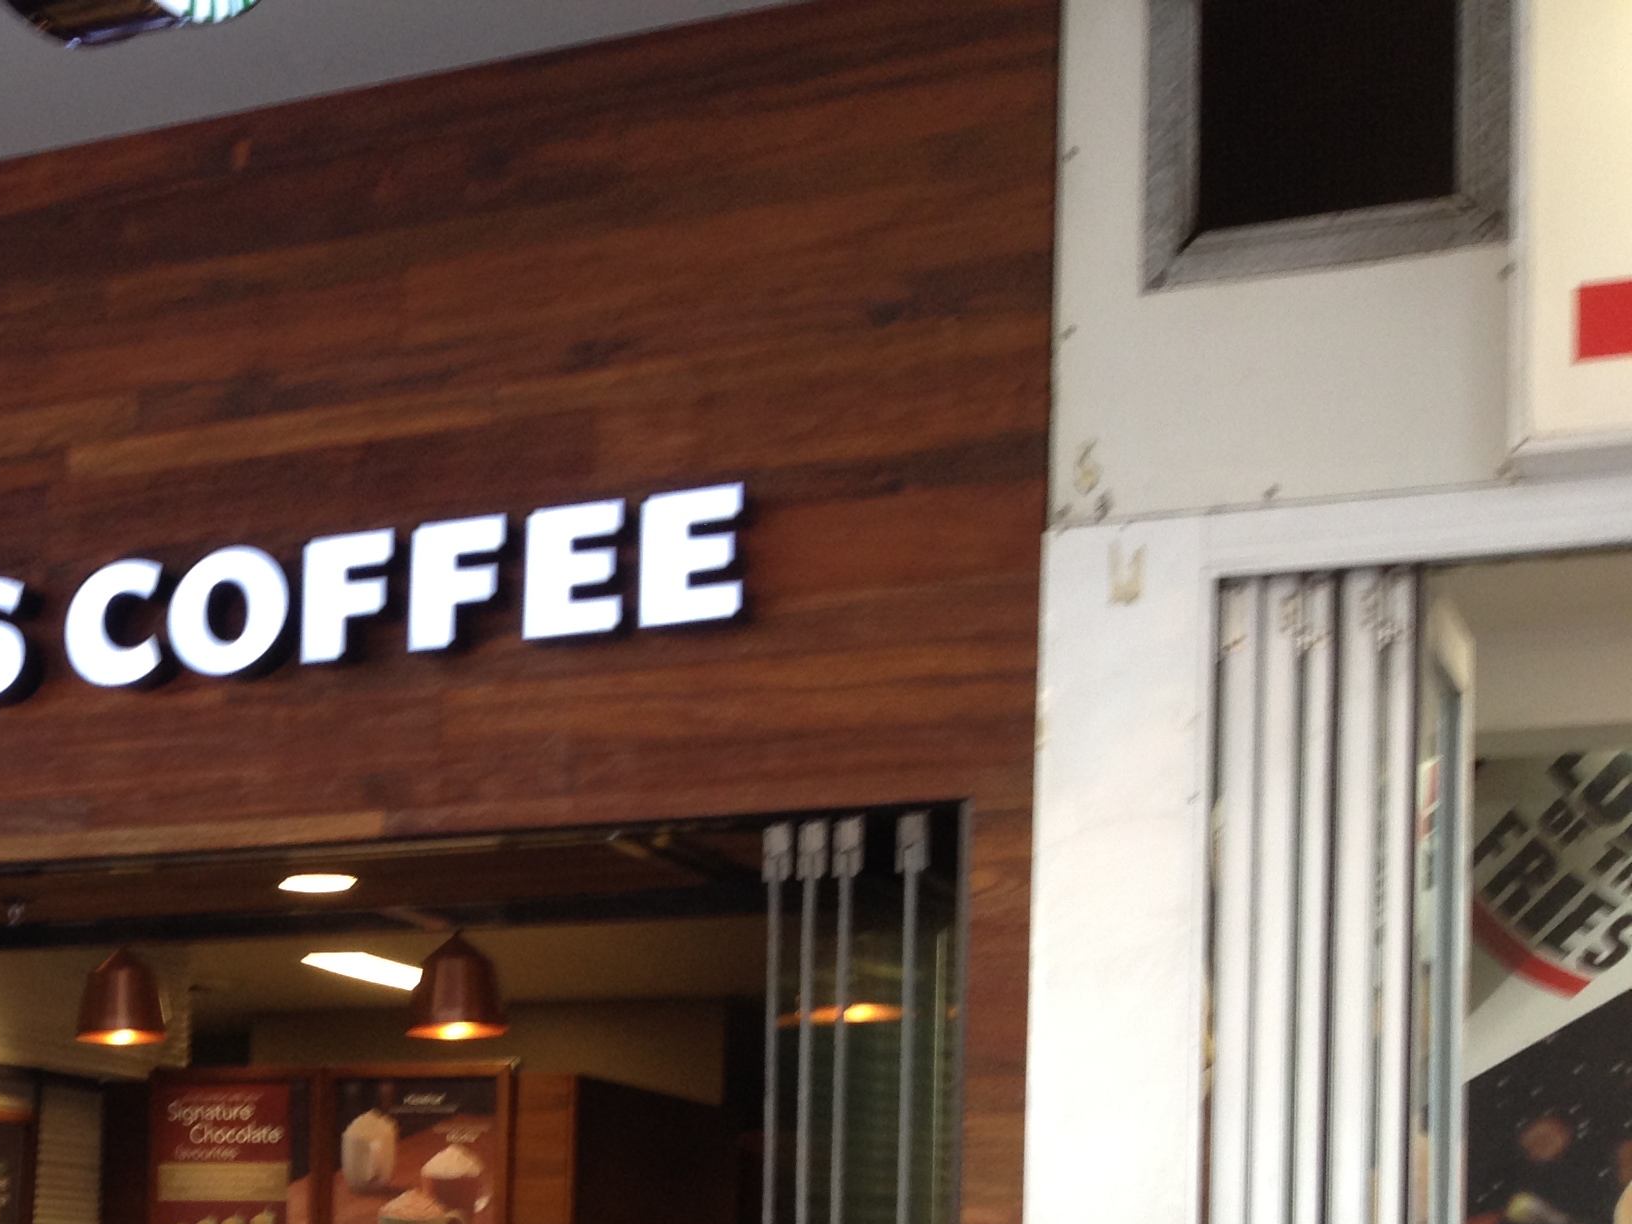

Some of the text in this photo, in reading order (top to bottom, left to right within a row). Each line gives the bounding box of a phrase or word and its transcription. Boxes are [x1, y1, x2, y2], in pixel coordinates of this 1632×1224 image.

[63, 481, 745, 688] COFFEE
[1473, 806, 1632, 975] FRIES
[168, 1099, 256, 1126] Signature
[189, 1120, 285, 1144] Chocolate
